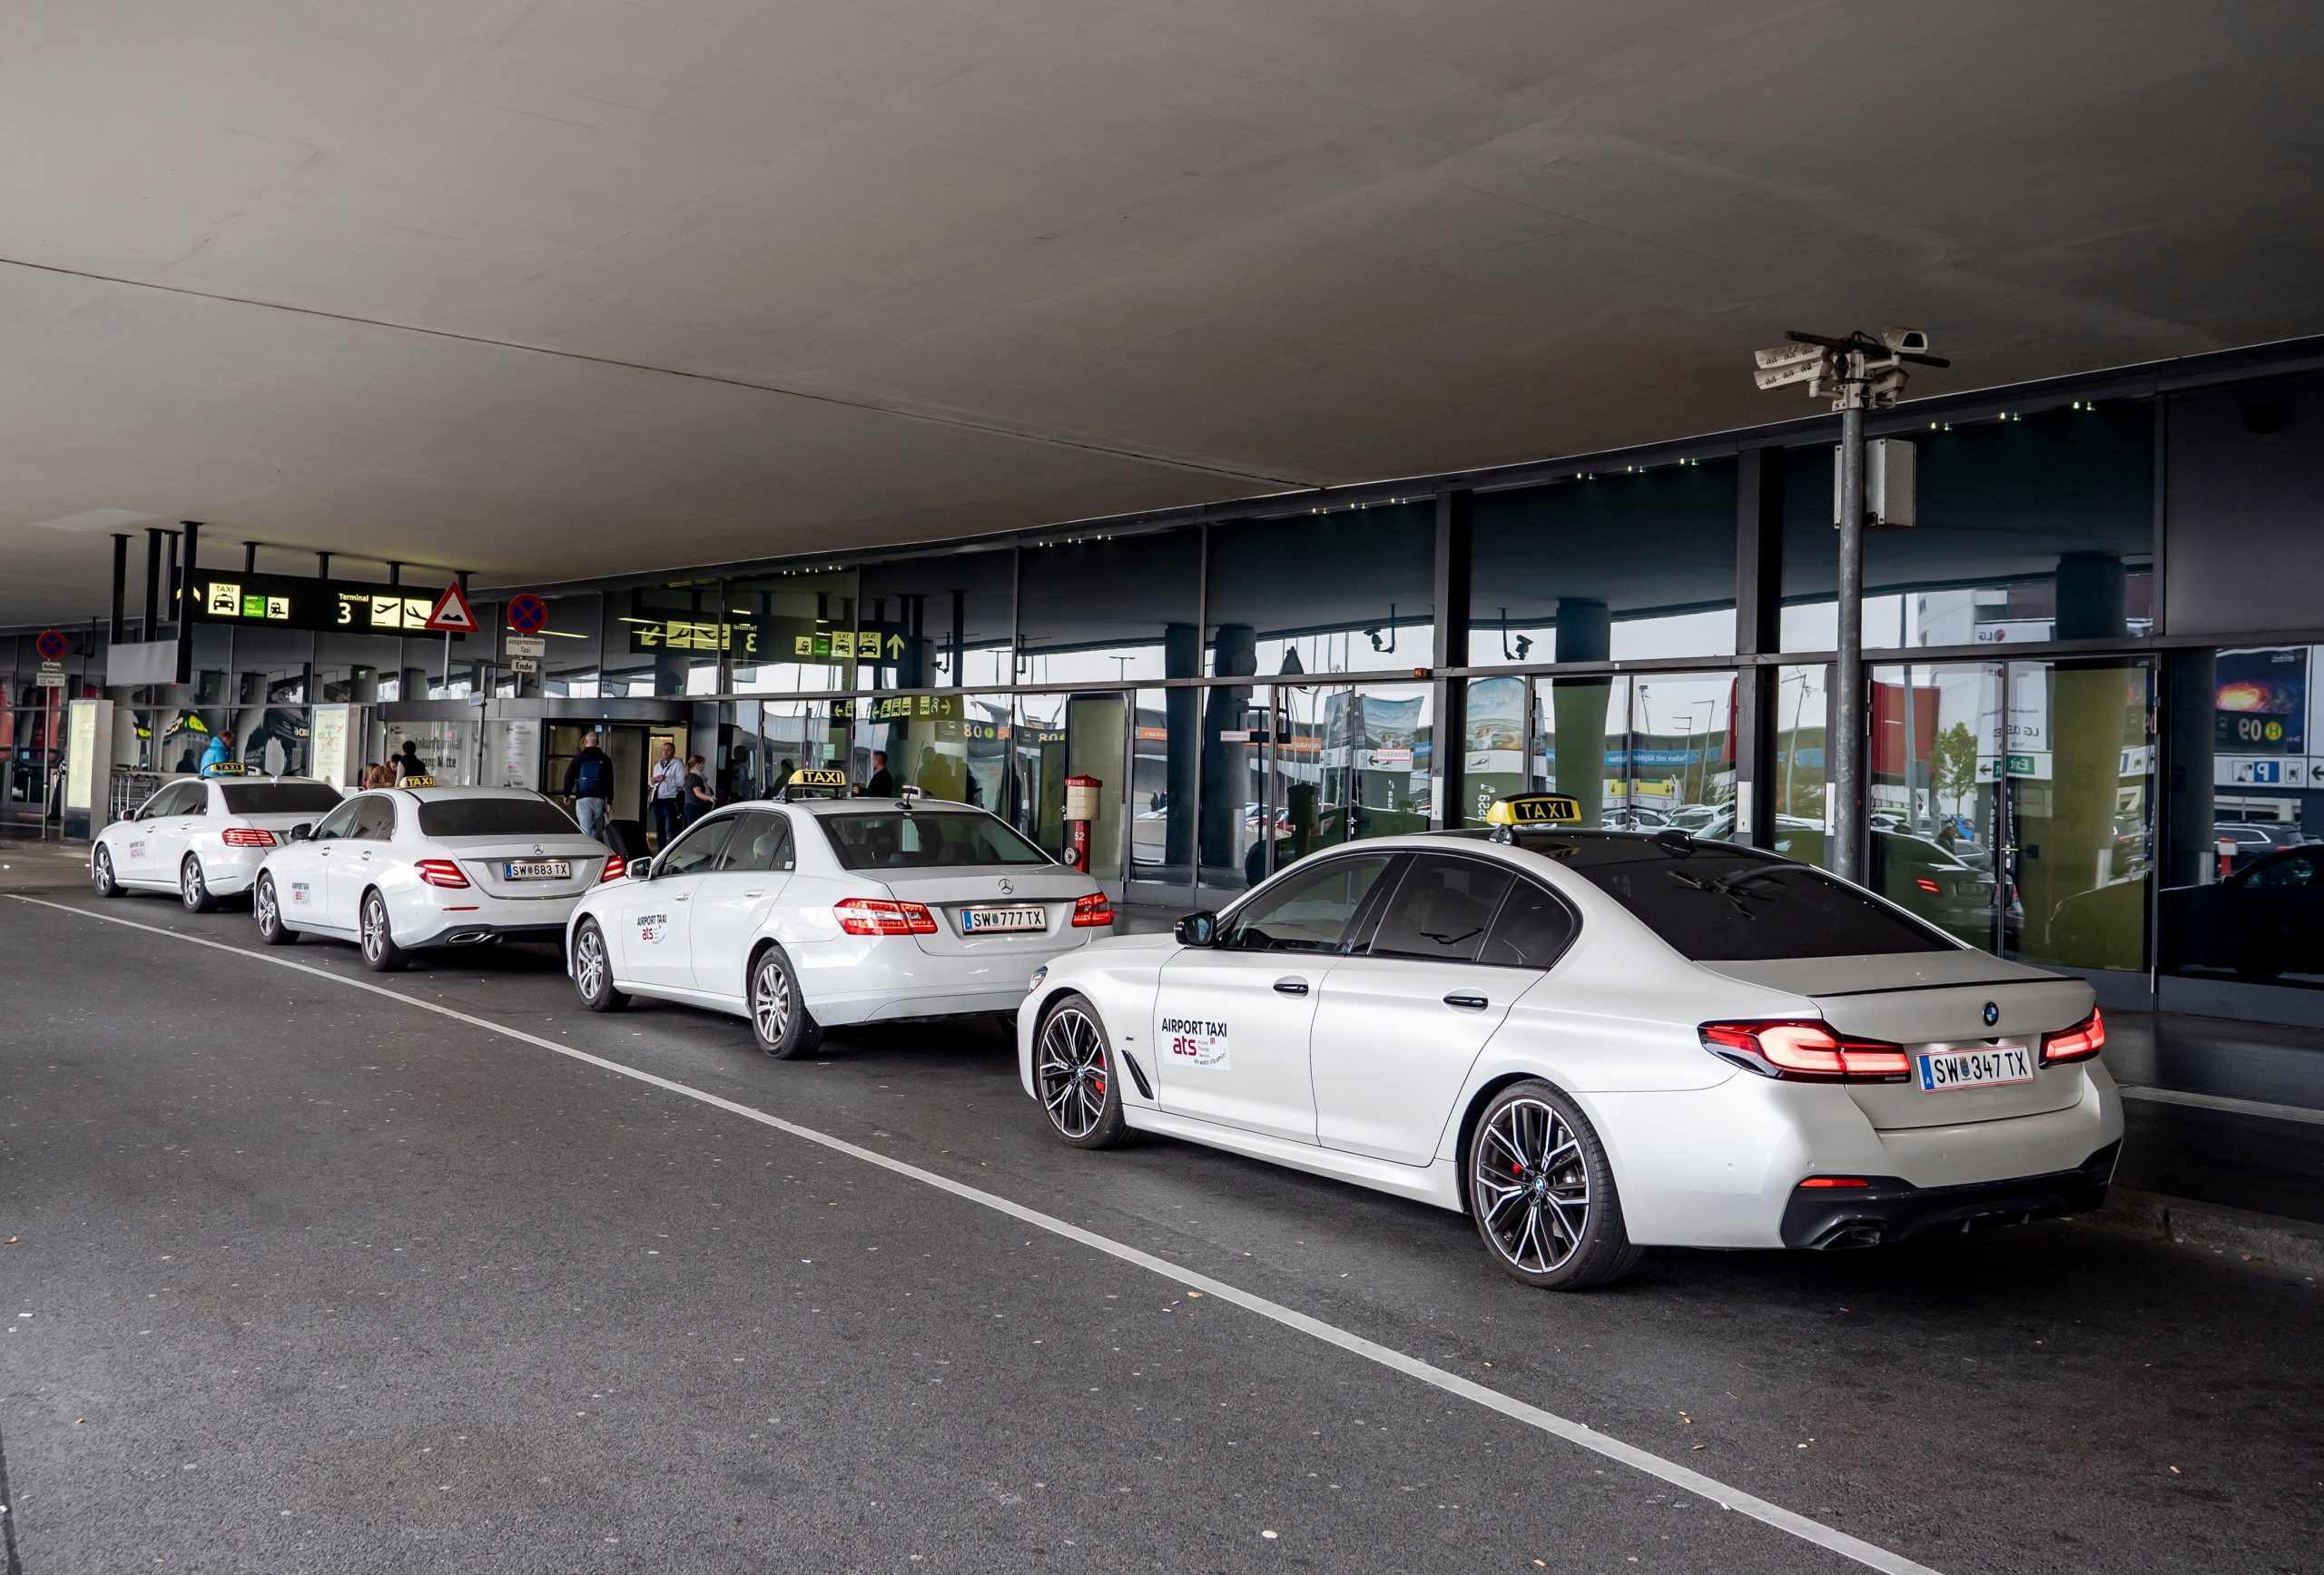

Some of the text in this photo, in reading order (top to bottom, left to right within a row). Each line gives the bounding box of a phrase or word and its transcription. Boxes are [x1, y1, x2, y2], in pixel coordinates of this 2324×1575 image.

[339, 593, 369, 602] Terminal
[337, 602, 351, 624] 3
[516, 662, 533, 671] Ende
[438, 755, 457, 768] Mtte
[408, 777, 434, 786] TAXI
[803, 772, 841, 783] TAXI
[1521, 802, 1567, 819] TAXI
[1074, 832, 1085, 841] 52
[512, 865, 527, 875] SW
[534, 865, 553, 875] 683
[555, 864, 566, 874] TX
[637, 913, 667, 927] AIRPORT TAXI
[973, 912, 990, 927] SW
[1000, 911, 1023, 926] 777
[1026, 911, 1041, 925] TX
[642, 927, 654, 940] ats
[1161, 1018, 1227, 1038] AIRPORT TAXI
[1173, 1035, 1197, 1057] ats
[1925, 1050, 2027, 1085] A SW 347 TX
